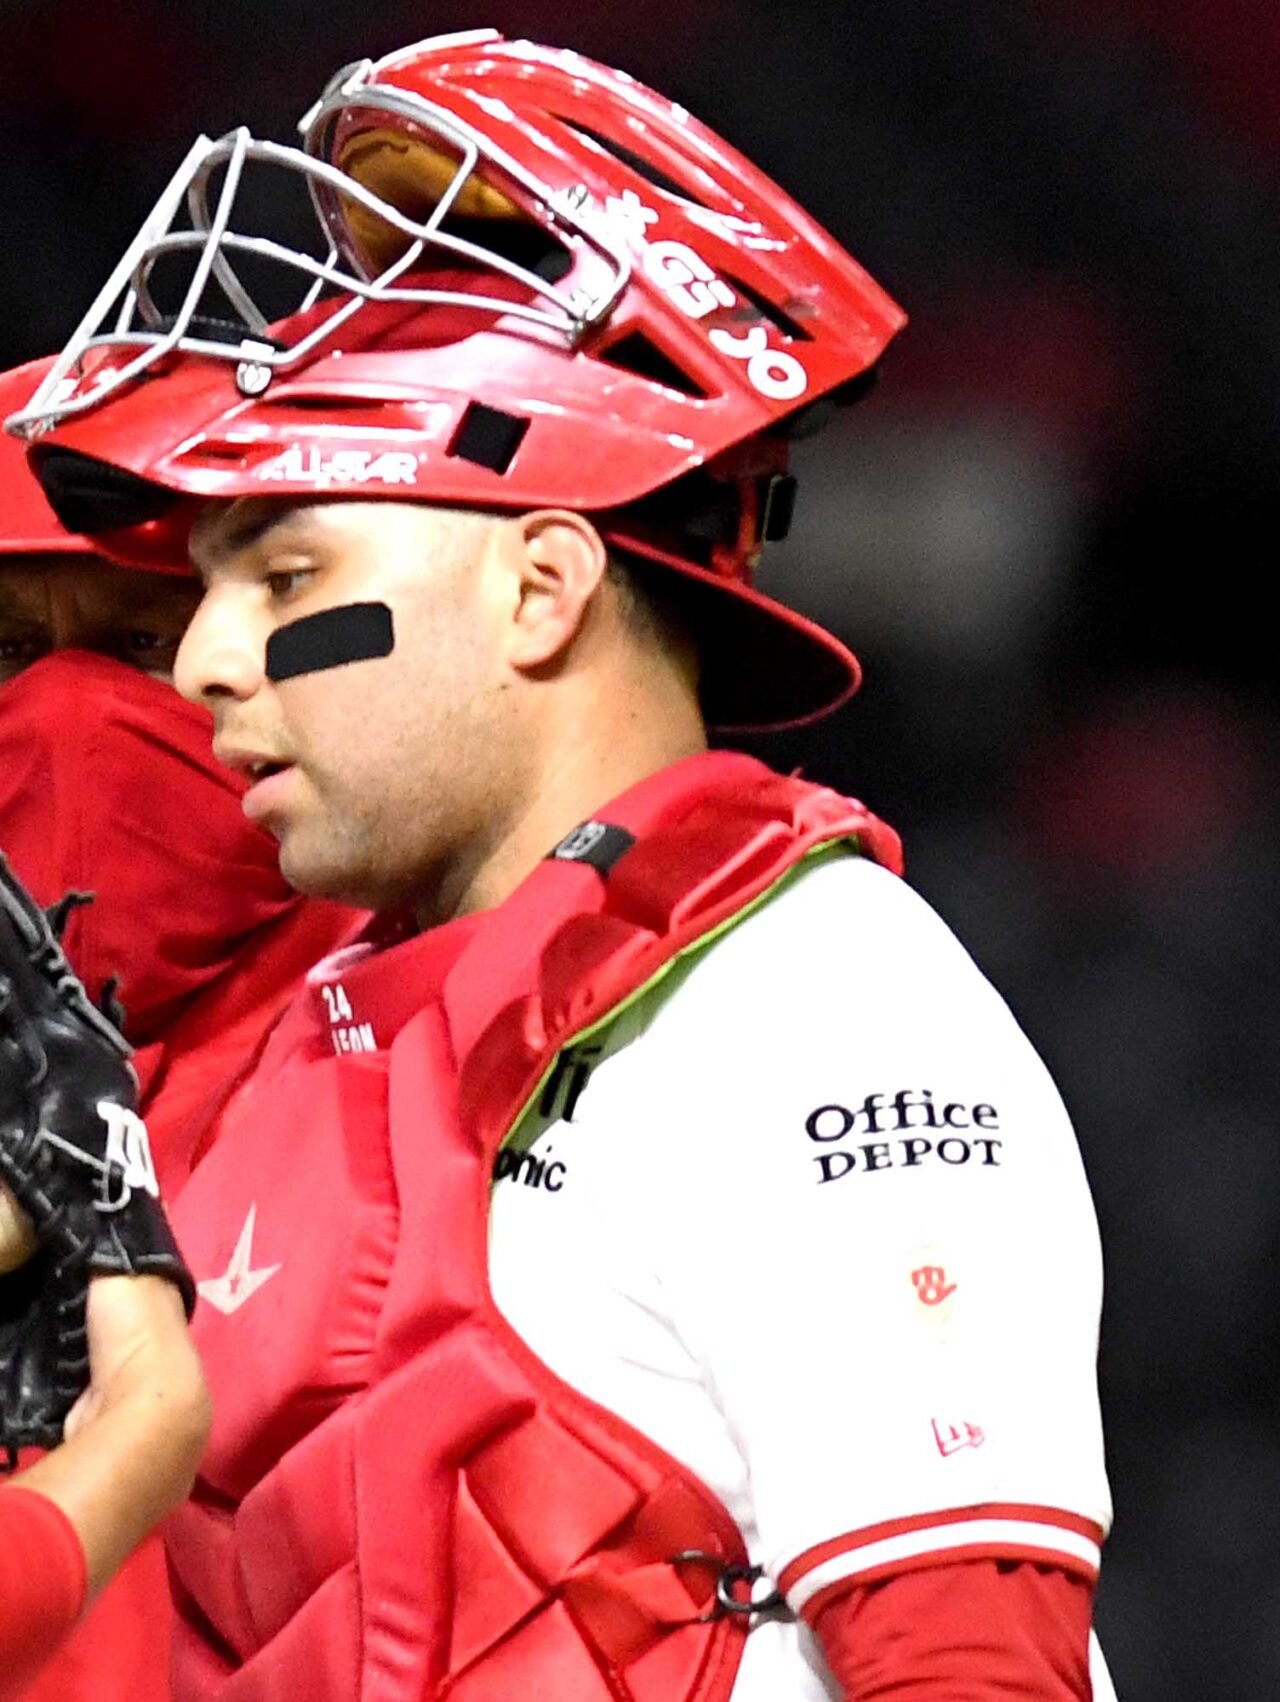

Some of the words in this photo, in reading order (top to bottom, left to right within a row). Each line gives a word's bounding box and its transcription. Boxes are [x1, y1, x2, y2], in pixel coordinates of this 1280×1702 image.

[321, 983, 353, 1024] 24
[804, 1088, 1000, 1143] Office
[812, 1137, 1003, 1185] DEPOT
